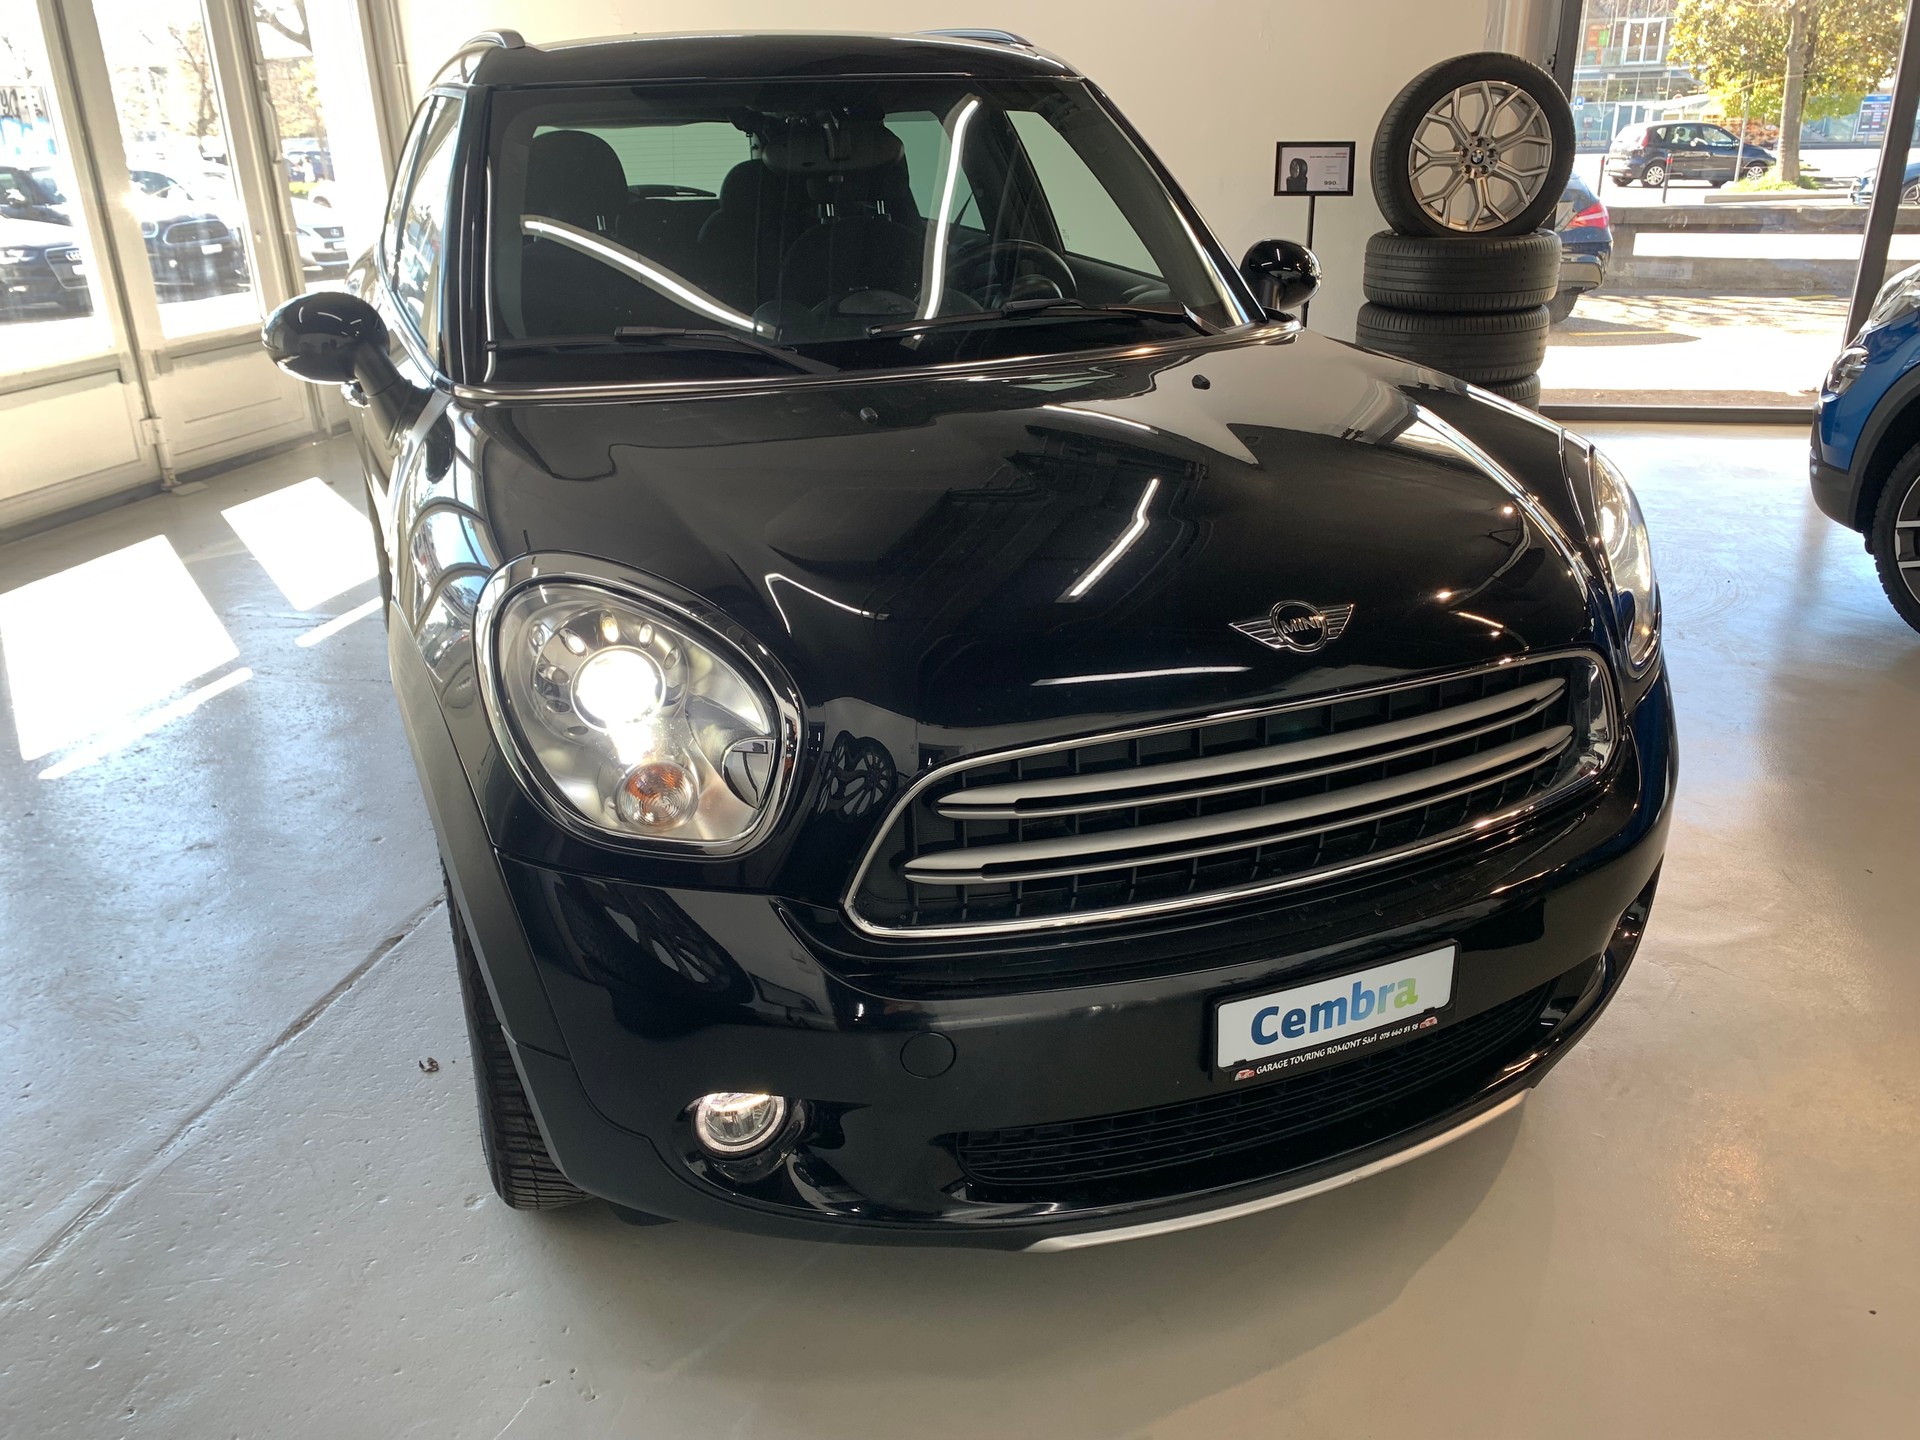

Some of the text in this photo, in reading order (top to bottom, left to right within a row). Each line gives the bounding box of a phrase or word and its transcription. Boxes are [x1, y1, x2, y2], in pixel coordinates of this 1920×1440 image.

[1280, 615, 1322, 634] MINI
[1250, 977, 1418, 1046] Cembra
[1256, 1059, 1289, 1074] GARAGE
[1290, 1048, 1326, 1065] TOURING
[1326, 1038, 1362, 1055] ROMONT
